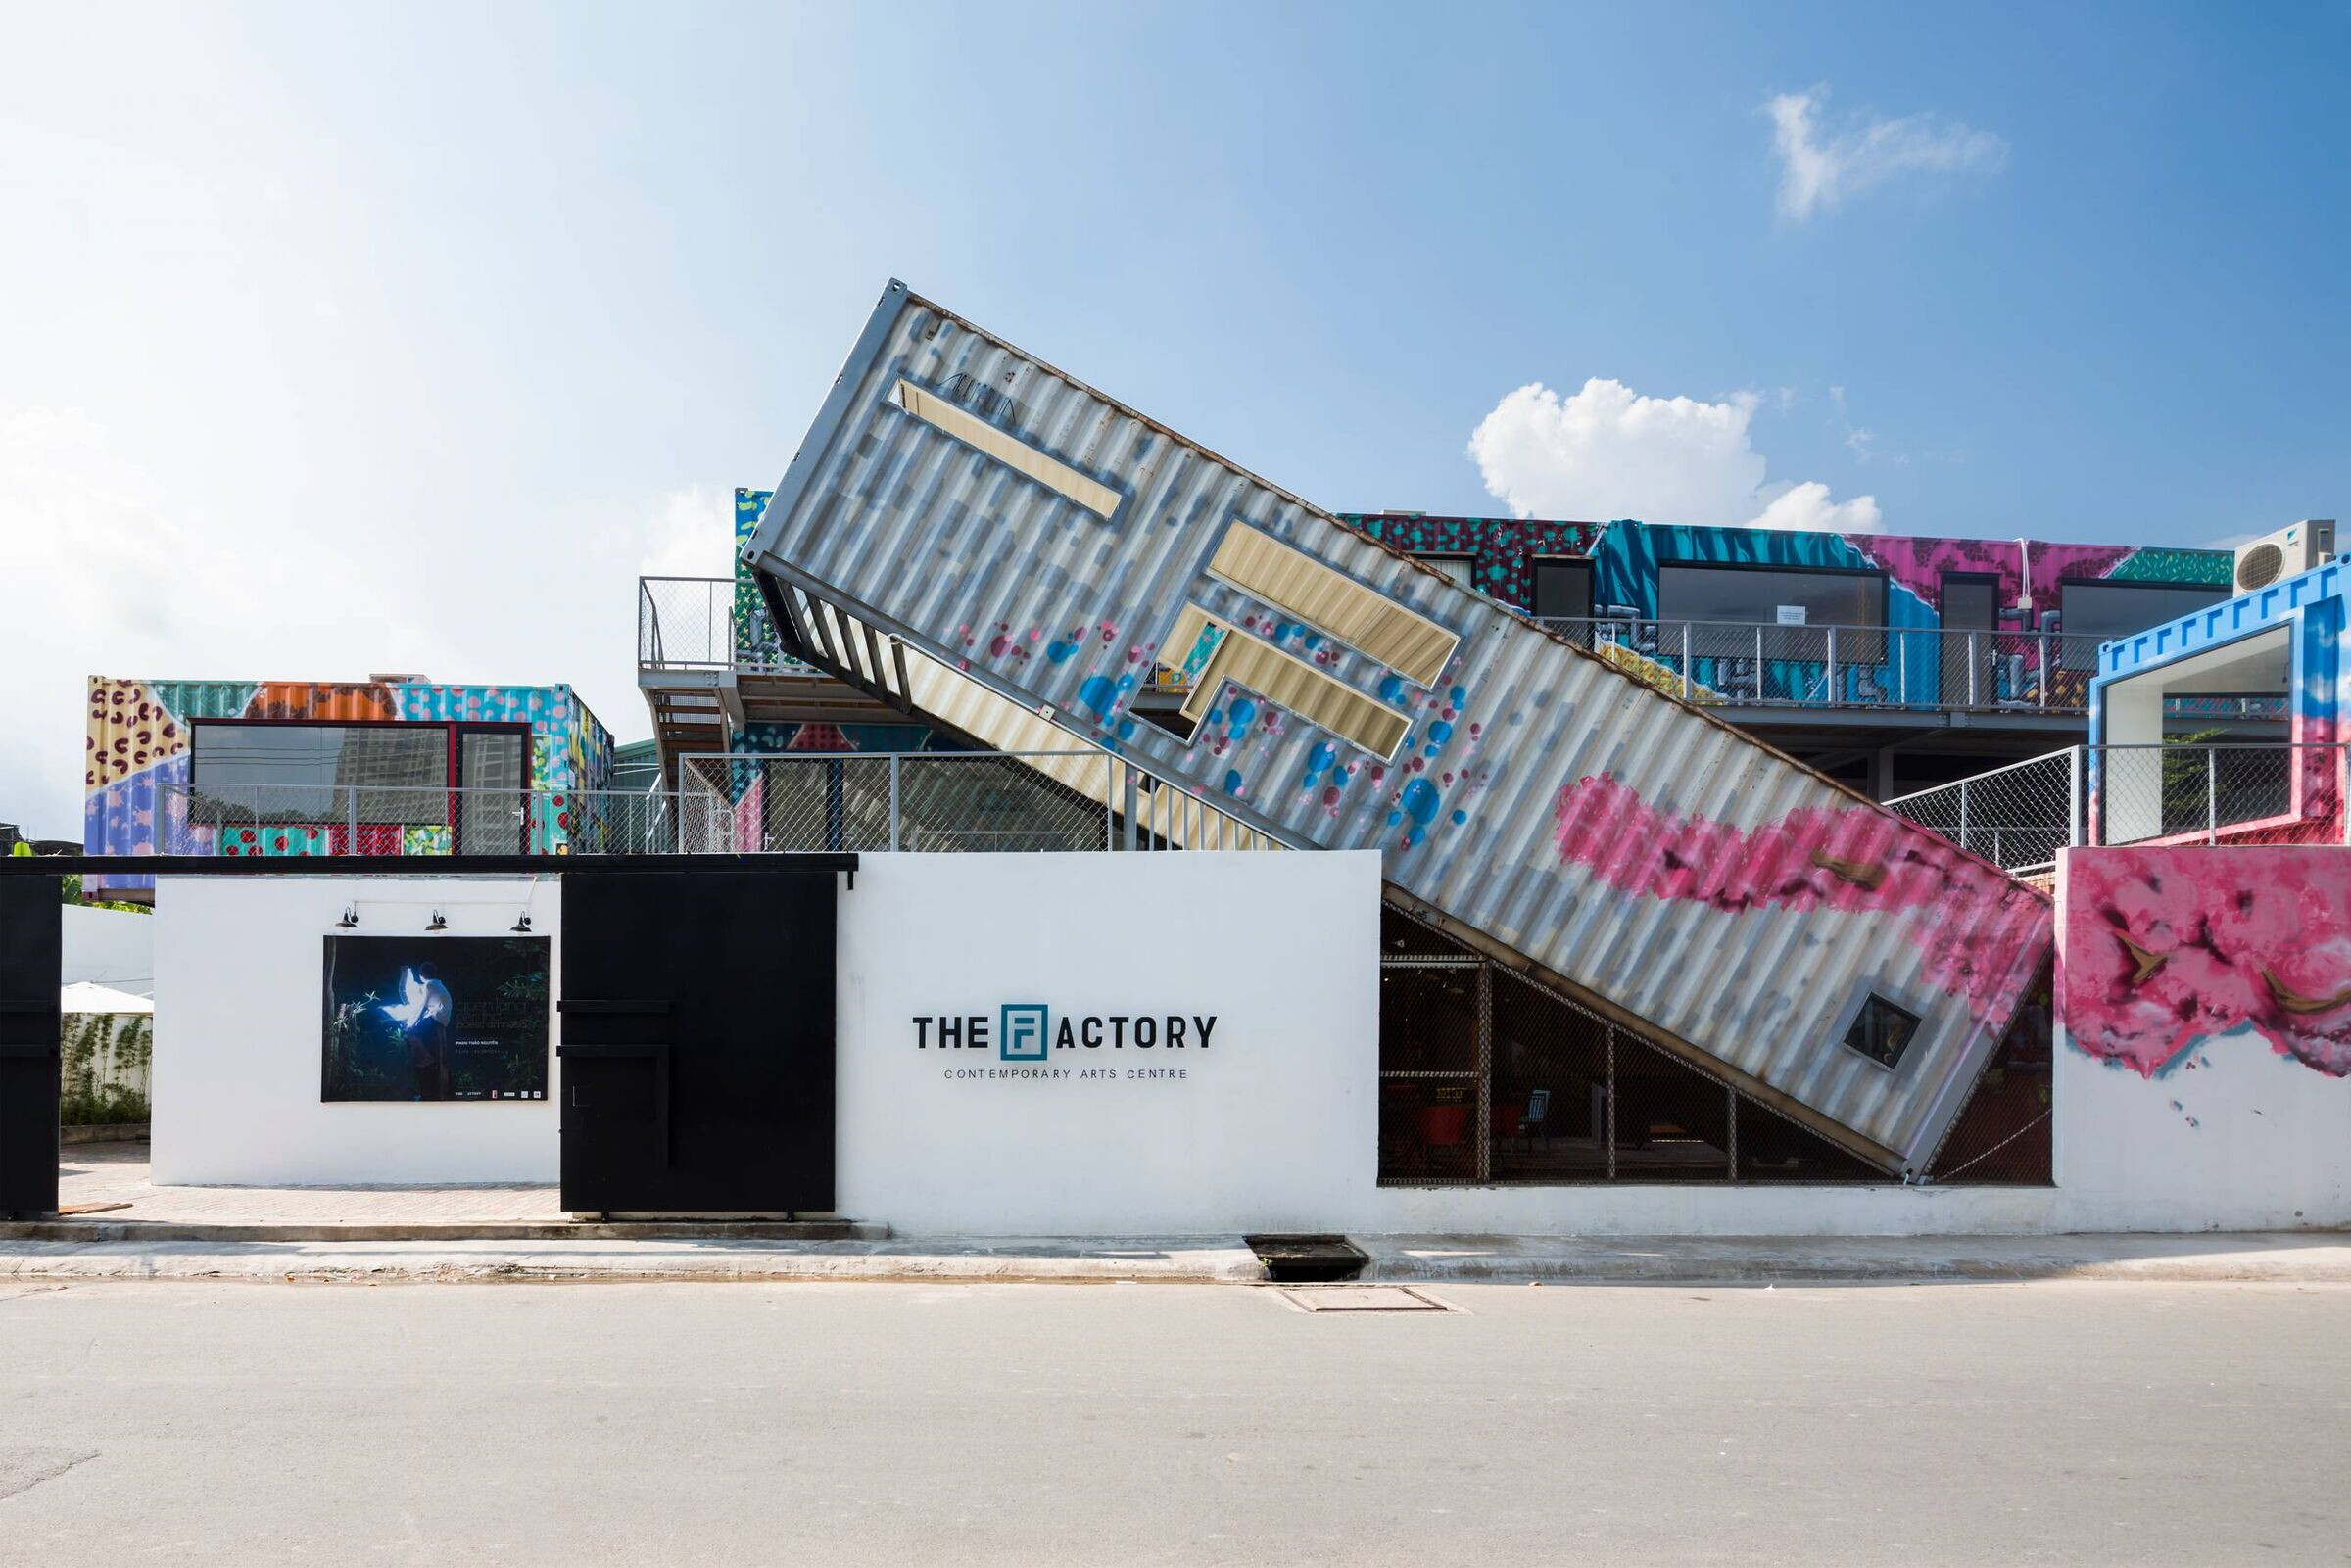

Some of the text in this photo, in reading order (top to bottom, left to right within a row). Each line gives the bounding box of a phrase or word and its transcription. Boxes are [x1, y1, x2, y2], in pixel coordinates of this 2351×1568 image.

[912, 1016, 1218, 1049] THE FACTORY
[943, 1069, 1187, 1079] CONTEMPORARY ARTS CENTRE
